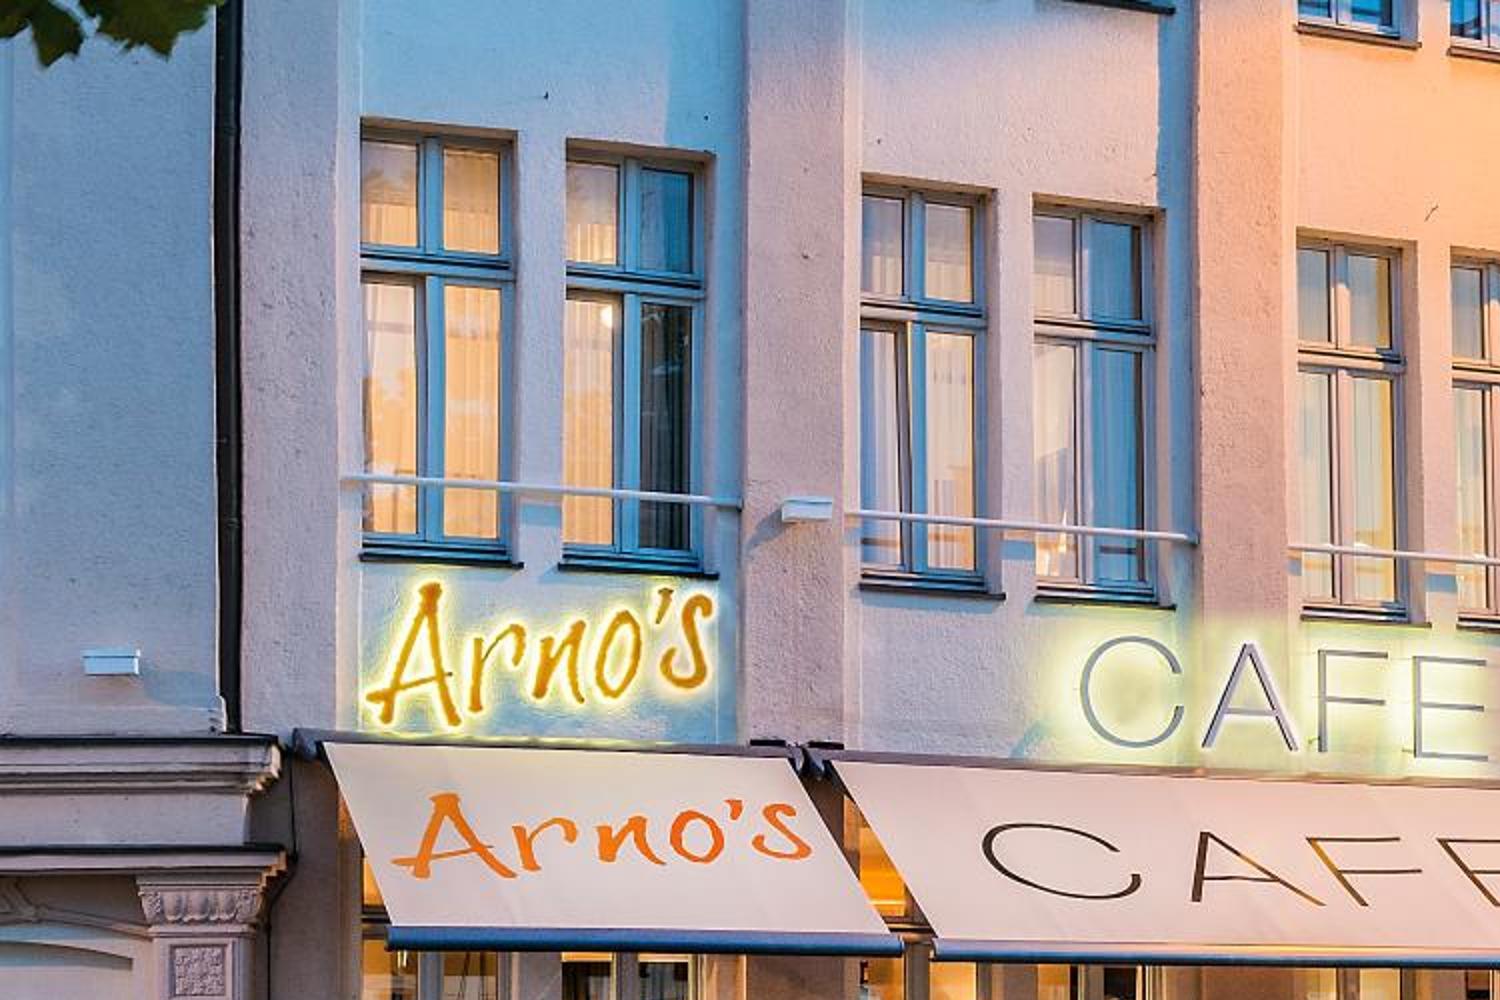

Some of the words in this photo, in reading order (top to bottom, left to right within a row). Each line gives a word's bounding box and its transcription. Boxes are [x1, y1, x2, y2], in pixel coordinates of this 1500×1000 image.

[366, 582, 713, 727] Arno's
[1080, 636, 1490, 762] CAFE
[391, 793, 813, 879] Arno's
